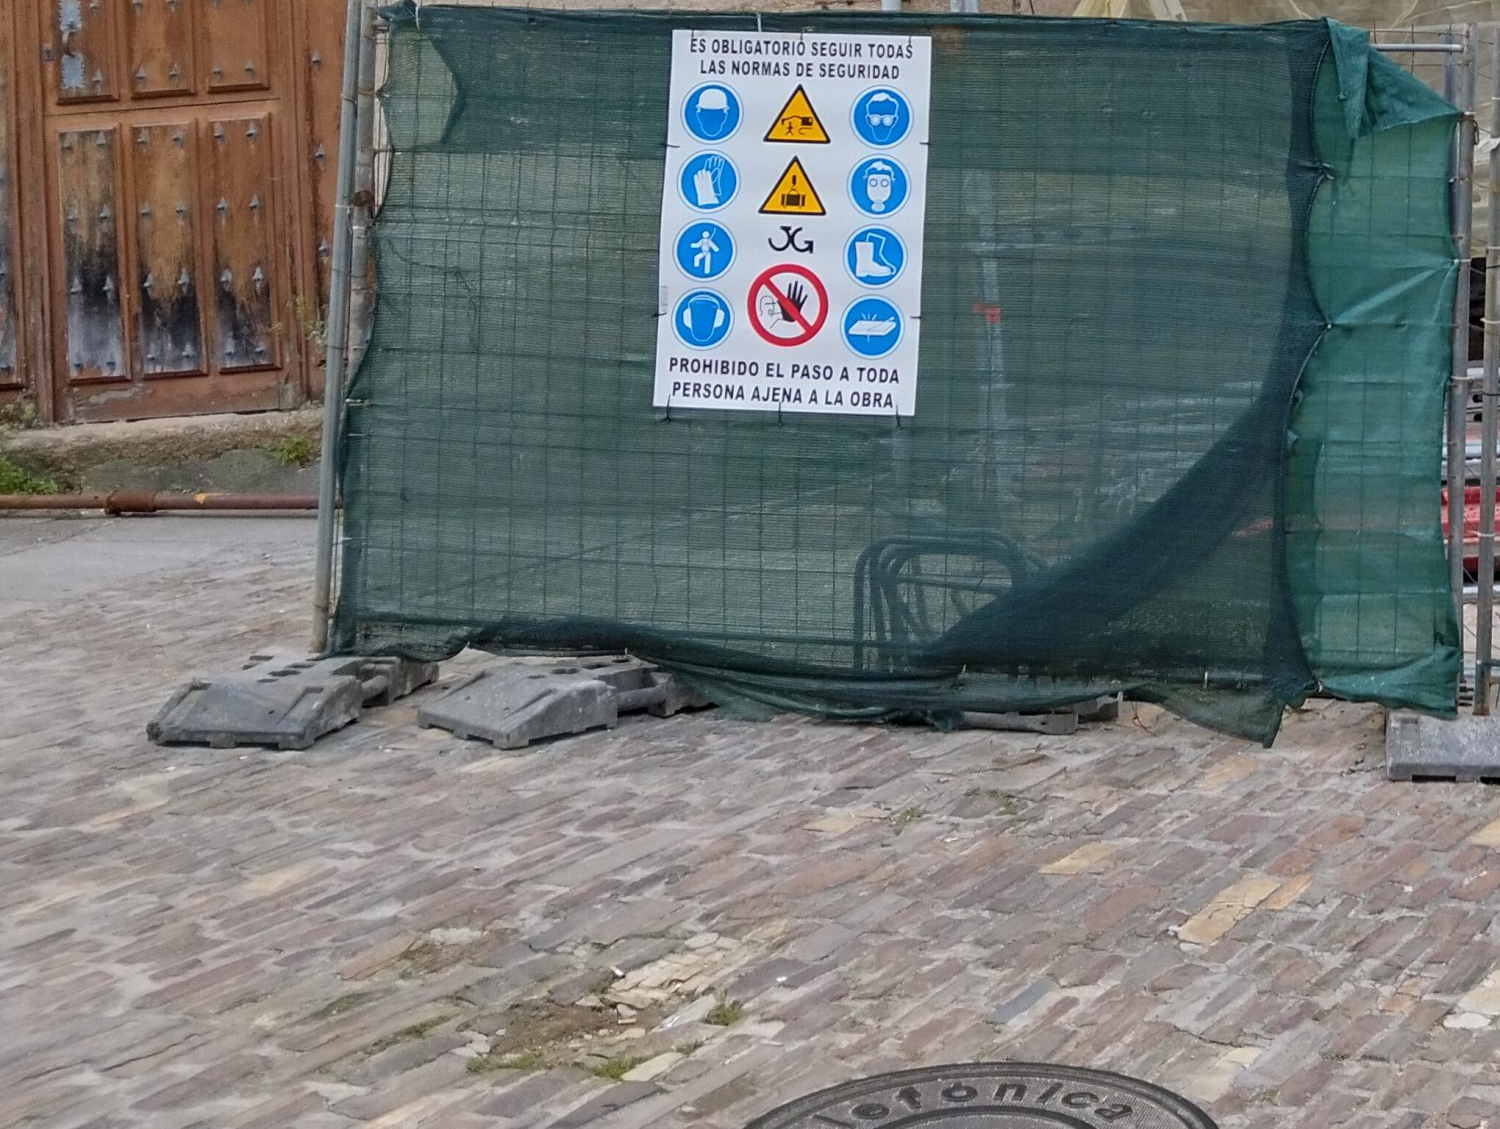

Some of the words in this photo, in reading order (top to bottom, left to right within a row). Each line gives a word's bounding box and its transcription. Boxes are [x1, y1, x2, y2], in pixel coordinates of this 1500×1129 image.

[690, 38, 706, 53] ES
[711, 39, 806, 57] OBLIGATORIO
[811, 42, 862, 58] SEGUIR
[868, 44, 913, 59] TODAS
[700, 59, 726, 75] LAS
[731, 60, 790, 76] NORMAS
[796, 62, 814, 77] DE
[819, 63, 900, 79] SEGURIDAD
[669, 357, 759, 377] PROHIBIDO
[765, 363, 785, 378] EL
[791, 364, 833, 381] PASO
[839, 367, 850, 382] A
[857, 367, 900, 384] TODA
[672, 381, 745, 400] PERSONA
[751, 386, 801, 404] AJENA
[808, 389, 818, 405] A
[824, 390, 843, 405] LA
[850, 391, 894, 409] OBRA
